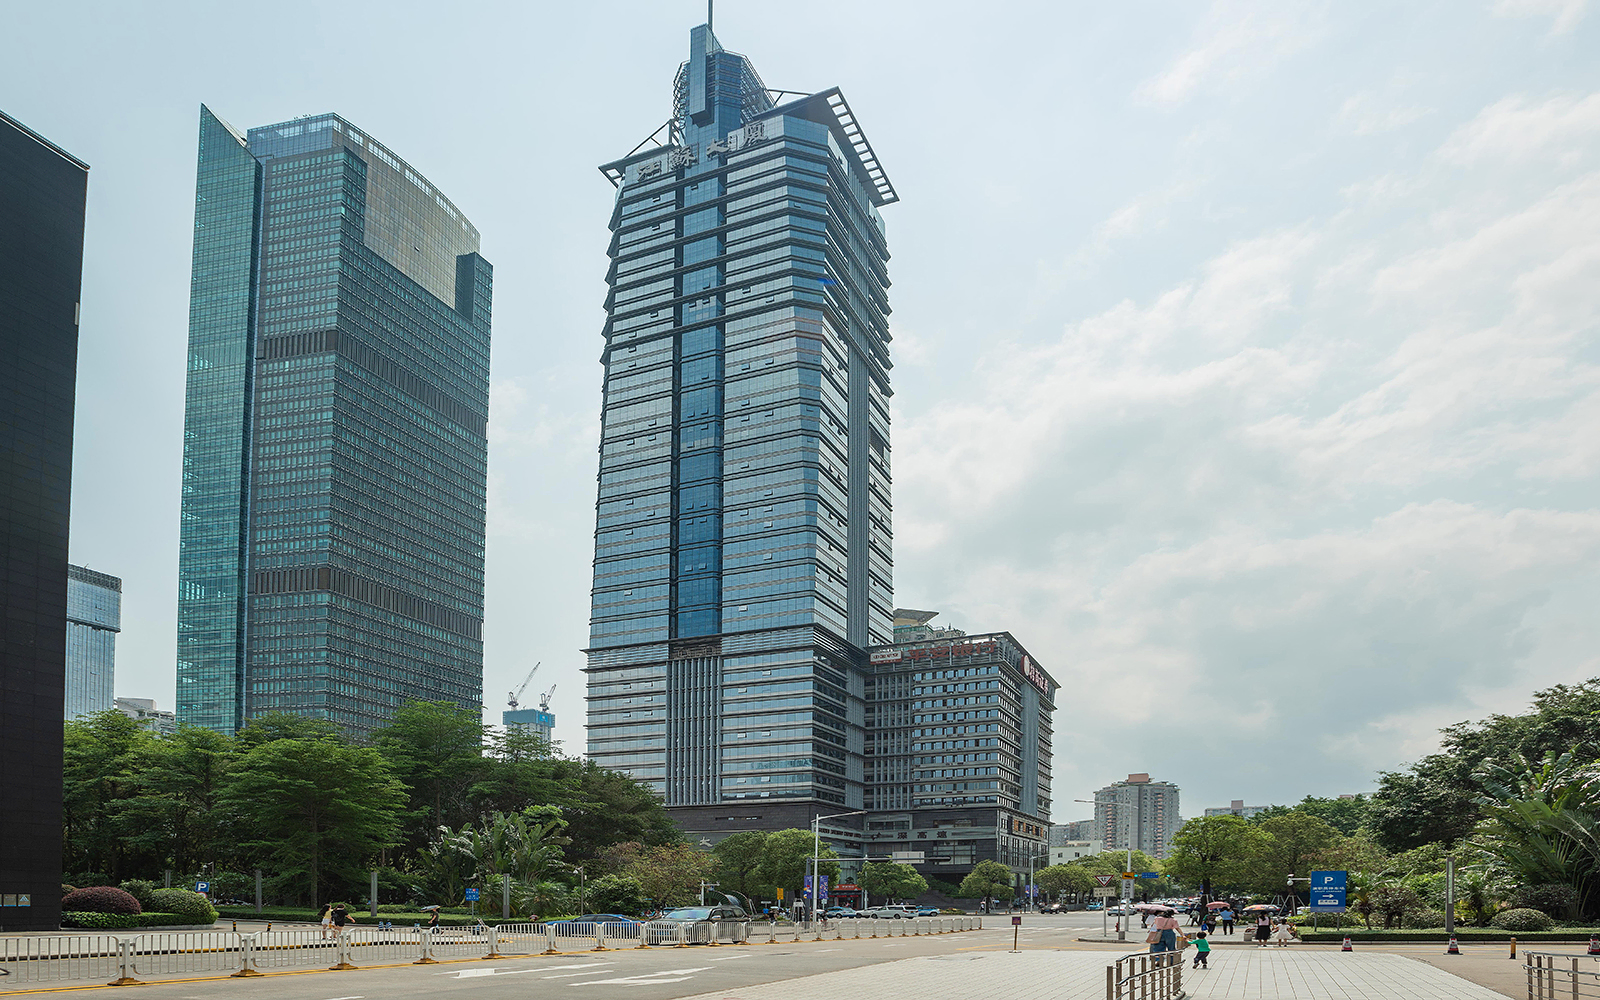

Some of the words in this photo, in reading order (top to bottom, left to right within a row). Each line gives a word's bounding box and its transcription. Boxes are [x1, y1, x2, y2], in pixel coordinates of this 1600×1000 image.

[907, 641, 997, 660] 平安银行
[1324, 876, 1334, 884] P
